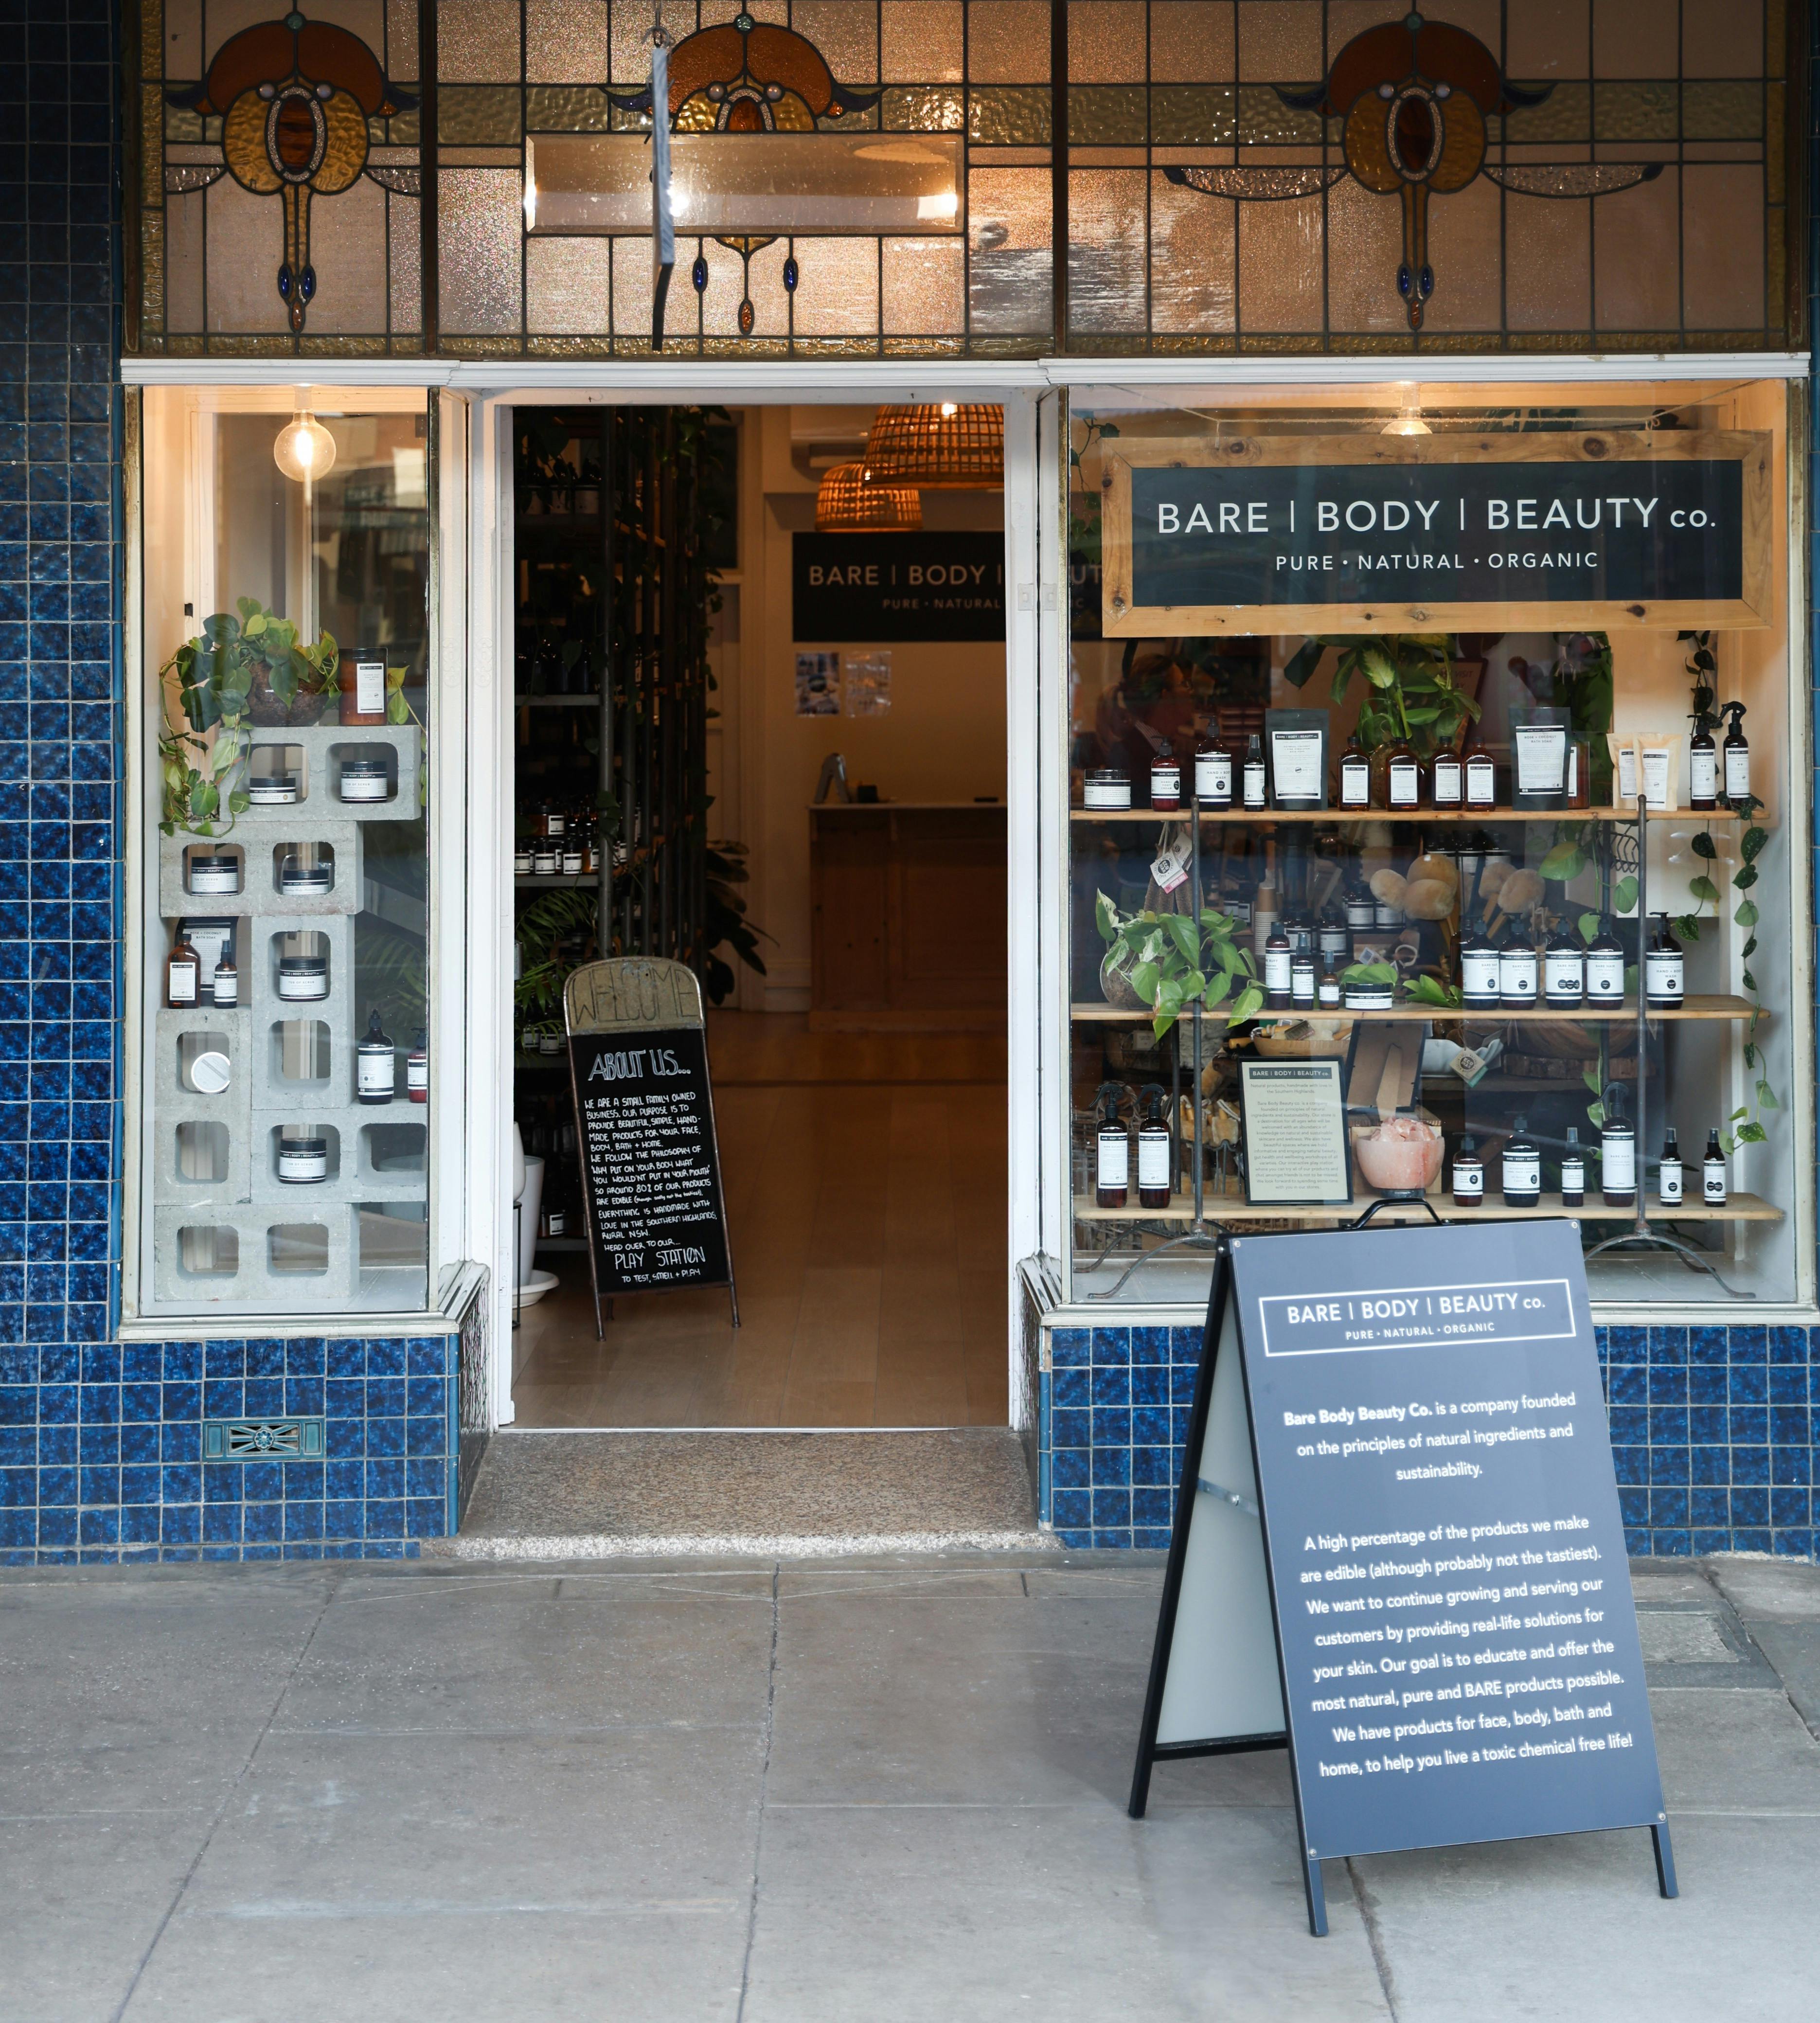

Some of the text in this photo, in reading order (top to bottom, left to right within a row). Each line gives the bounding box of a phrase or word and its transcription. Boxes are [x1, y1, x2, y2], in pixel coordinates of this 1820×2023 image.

[1159, 498, 1716, 534] BARE BODY BEAUTY co.
[1276, 552, 1598, 571] PURE NATURAL ORGANIC
[809, 565, 985, 586] BARE BODY
[883, 598, 1001, 609] PURE NATURAL
[573, 966, 698, 1025] WELCOME
[588, 1049, 646, 1081] ABOUT
[584, 1091, 696, 1109] WE ARE A SMALL FAMILY OWNED
[622, 1109, 638, 1117] OUR
[639, 1106, 668, 1116] PURPOSE
[670, 1105, 678, 1113] IS
[678, 1104, 689, 1112] TO
[589, 1132, 609, 1142] MADE
[612, 1130, 643, 1141] PRODUCTS
[644, 1129, 659, 1137] FOR
[659, 1128, 680, 1136] YOUR
[590, 1154, 601, 1163] WE
[605, 1152, 633, 1163] FOLLOW
[651, 1146, 691, 1158] PHILOSOPHY
[692, 1145, 702, 1153] OF
[607, 1186, 634, 1195] AROUND
[654, 1182, 663, 1191] OF
[665, 1182, 681, 1190] OUR
[682, 1178, 712, 1189] PRODUCTS
[598, 1208, 640, 1219] EVERYTHING
[653, 1202, 690, 1214] HANDMADE
[692, 1199, 711, 1208] WITH
[601, 1231, 625, 1240] RURAL
[625, 1242, 646, 1251] OVER
[614, 1252, 644, 1270] PLAY
[681, 1268, 701, 1277] PLAY
[1287, 1293, 1545, 1324] BARE BODY BEAUTY co.
[1345, 1322, 1495, 1340] PURE NATURAL ORGANIC
[1283, 1392, 1576, 1426] Bare Body Beauty Co. is a company founded
[1296, 1422, 1574, 1457] on the principles of natural ingredients and
[1395, 1461, 1483, 1481] sustainability.
[1304, 1515, 1589, 1553] A high percentage of the products we make
[1300, 1545, 1602, 1583] are edible (although probably not the tastiest).
[1311, 1670, 1624, 1712] most natural, pure and BARE products possible.
[1319, 1733, 1633, 1777] home, to help you live a toxic chemical free life!
